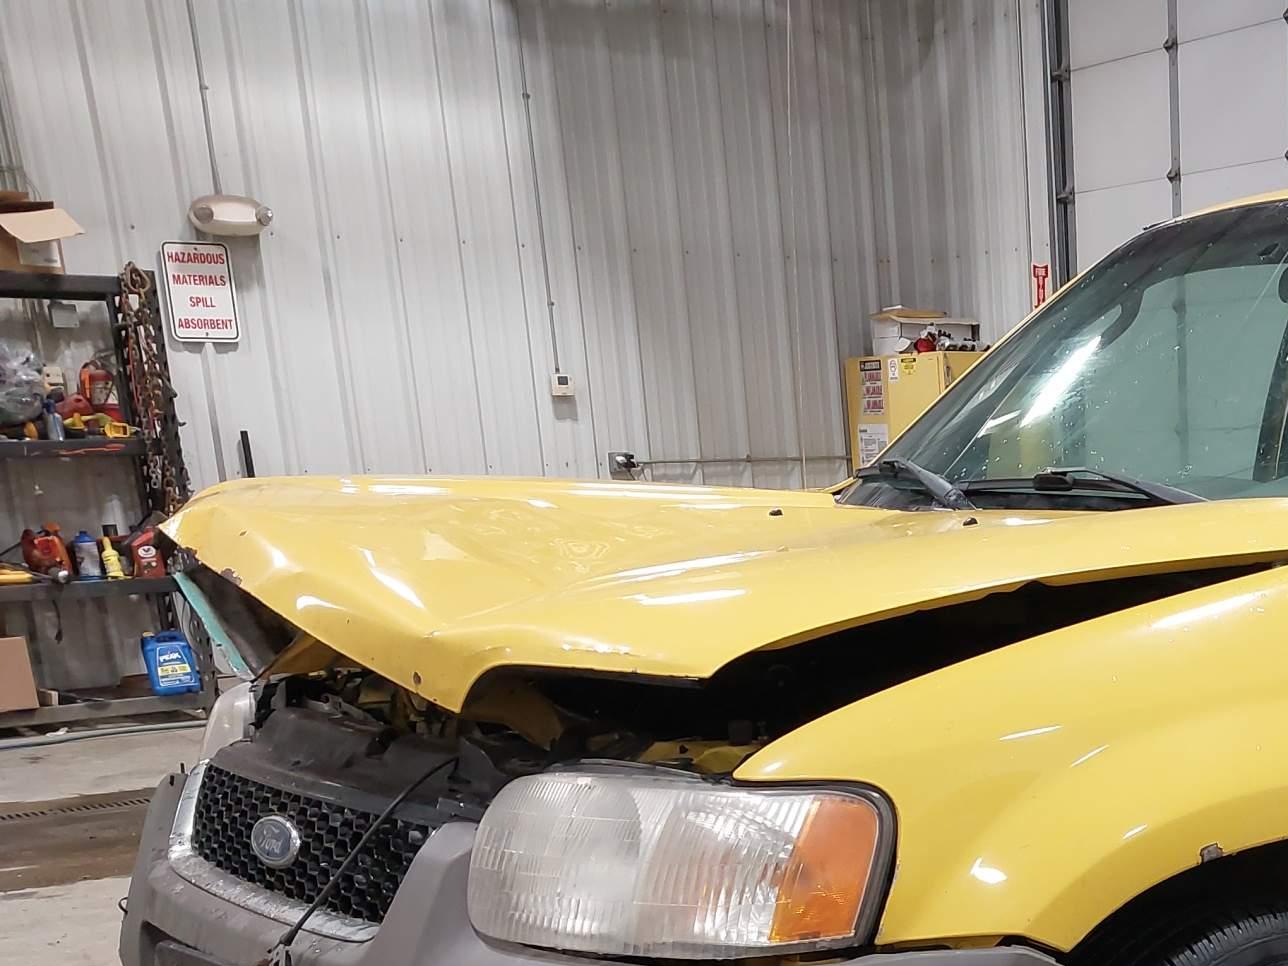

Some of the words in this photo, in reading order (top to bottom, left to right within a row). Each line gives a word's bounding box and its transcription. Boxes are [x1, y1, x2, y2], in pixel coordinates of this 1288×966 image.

[166, 251, 225, 265] HAZARDOUS
[172, 274, 227, 286] MATERIALS
[189, 296, 217, 308] SPILL
[178, 318, 233, 330] ABSORBENT
